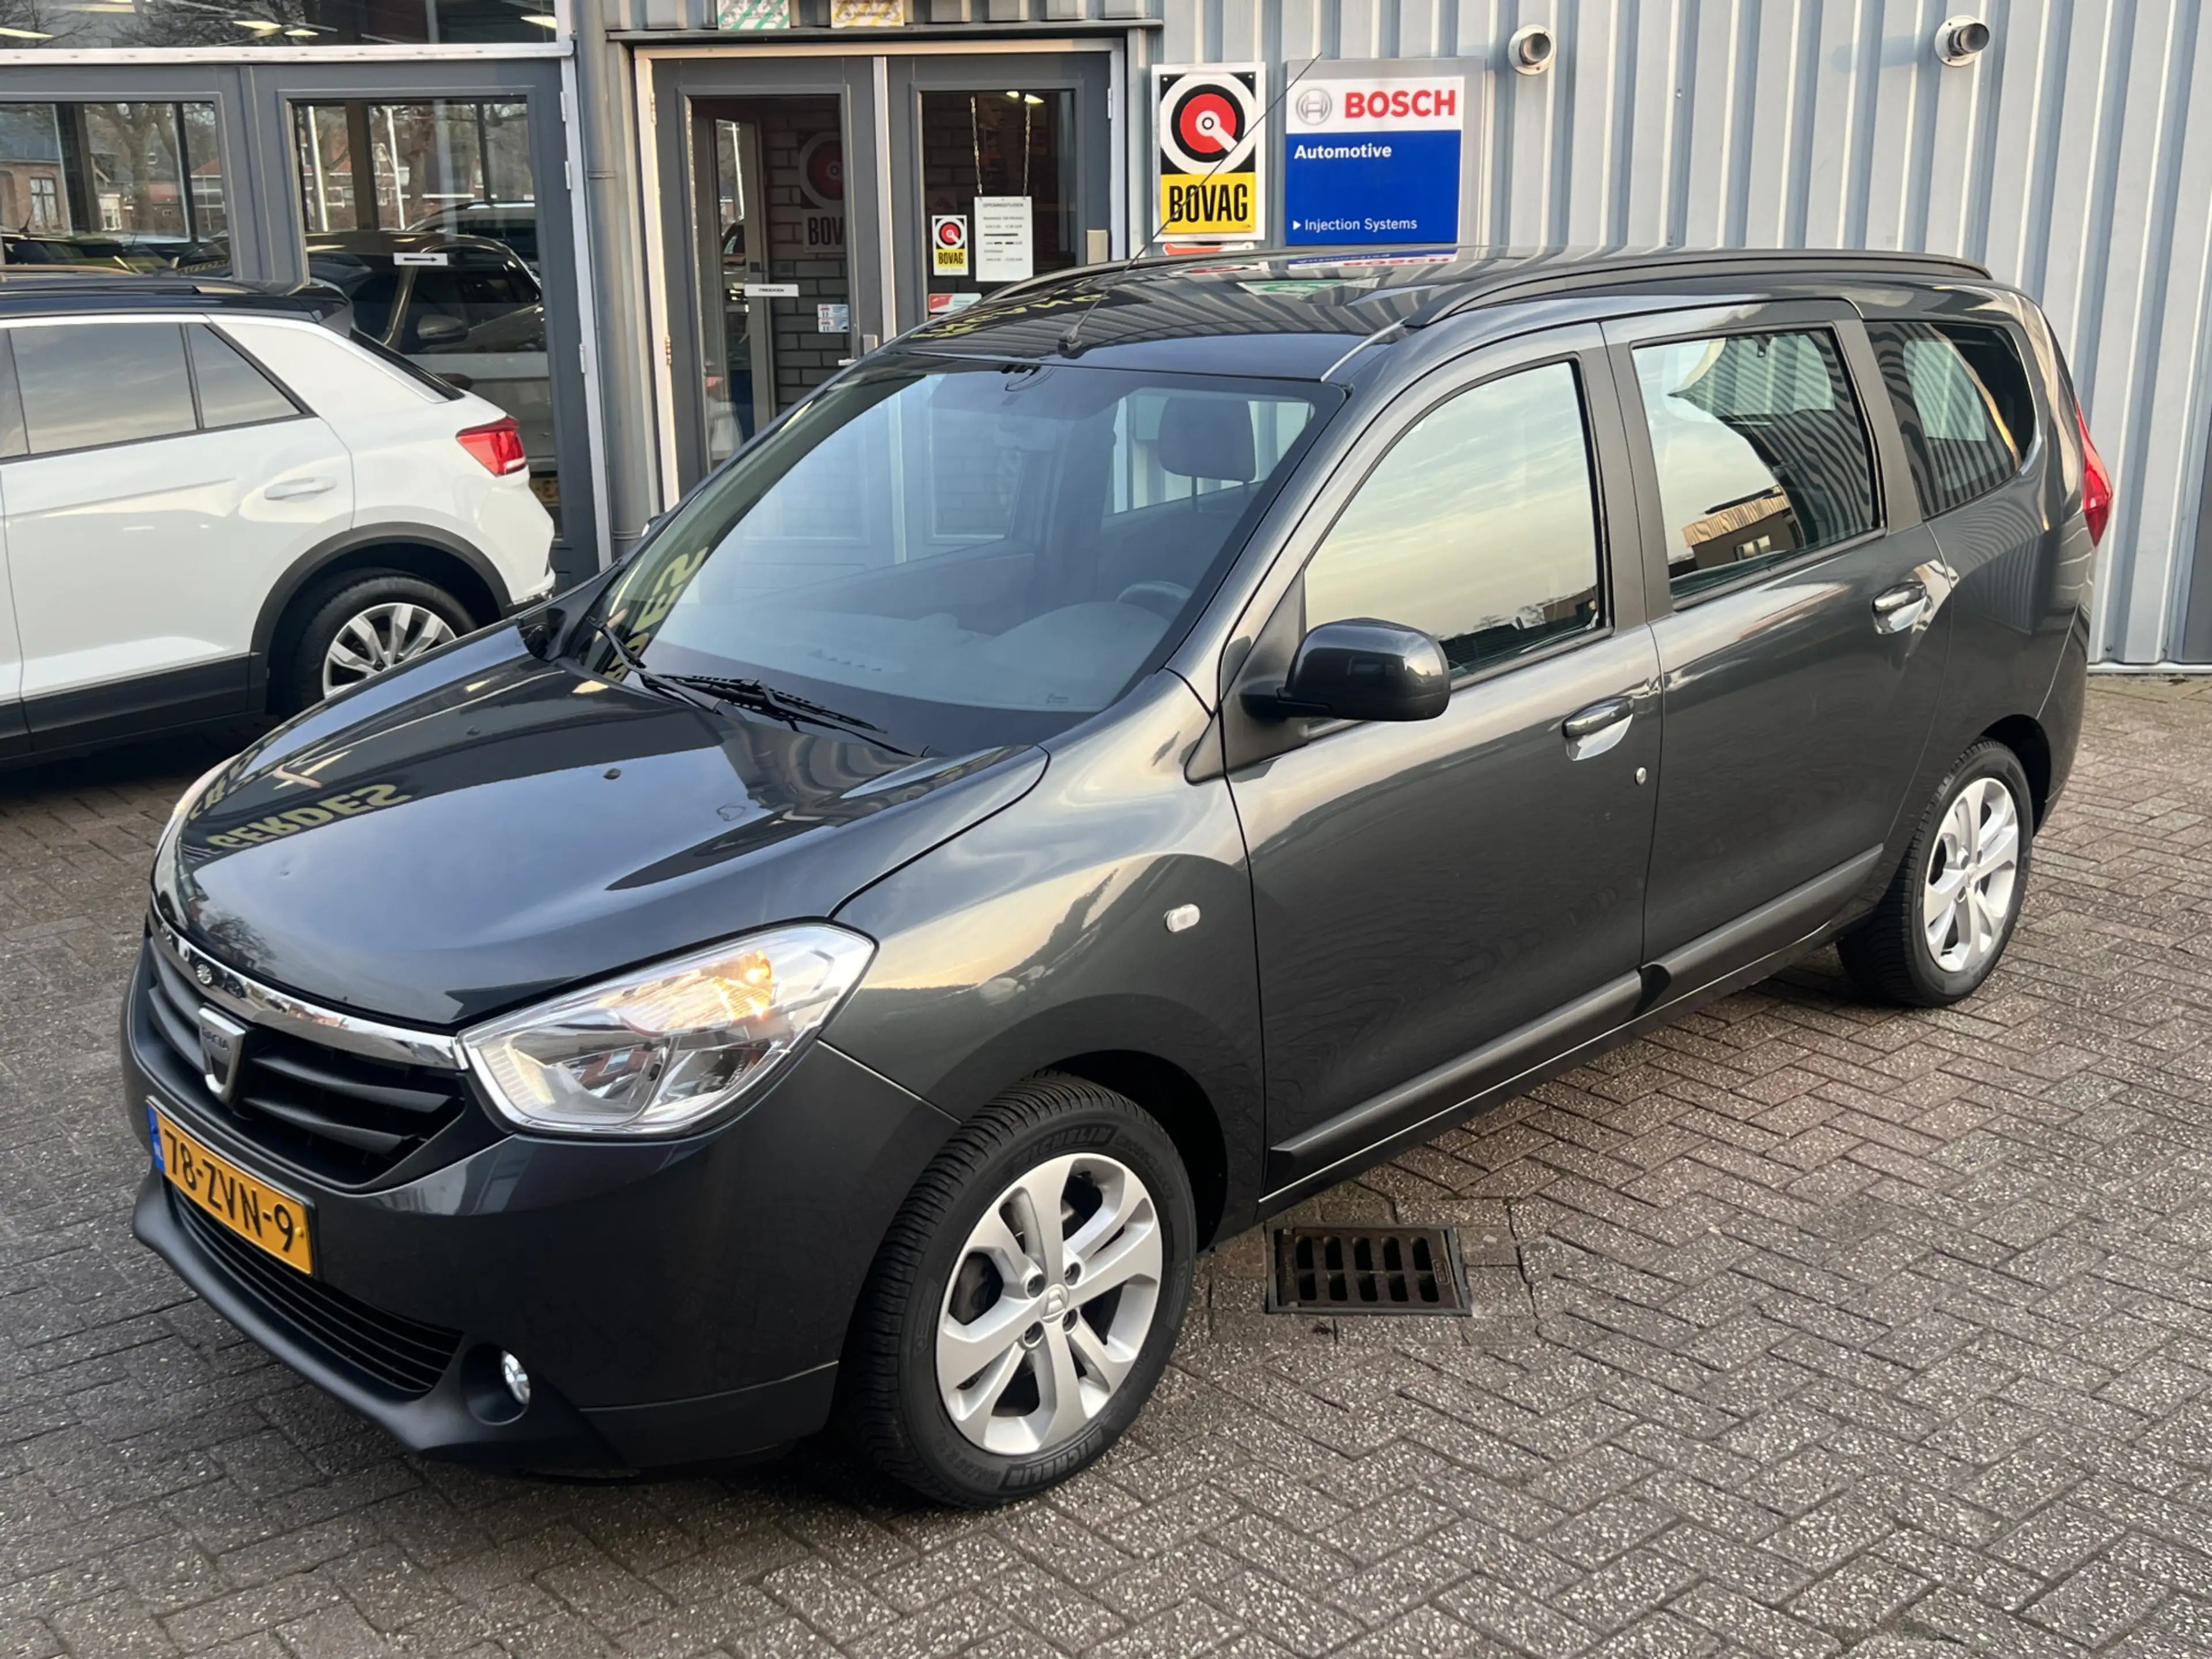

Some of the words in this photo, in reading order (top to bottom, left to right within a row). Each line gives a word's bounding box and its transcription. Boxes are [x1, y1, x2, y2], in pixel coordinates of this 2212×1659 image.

[1344, 90, 1455, 119] BOSCH
[1294, 143, 1393, 160] Automotive
[1169, 183, 1248, 222] BOVAG
[1305, 217, 1361, 232] Injection
[1365, 217, 1417, 232] Systems
[938, 252, 964, 265] BOVAG
[164, 1129, 295, 1253] 78-ZVN-9
[1005, 1428, 1105, 1487] MICHELIN
